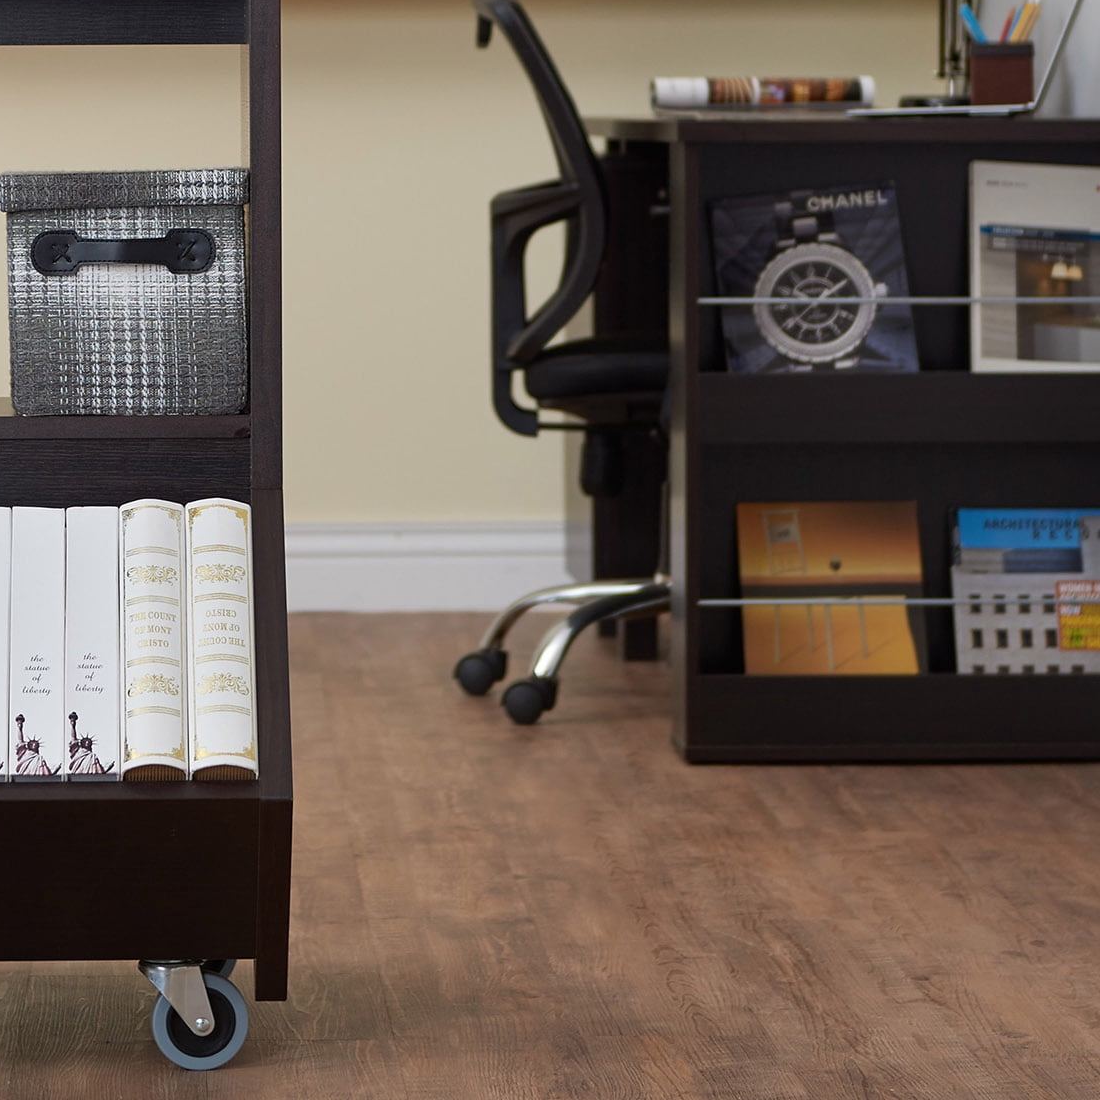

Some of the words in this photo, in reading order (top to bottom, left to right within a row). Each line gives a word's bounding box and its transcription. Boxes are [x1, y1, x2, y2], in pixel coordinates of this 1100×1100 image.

[807, 189, 888, 212] CHANEL
[129, 613, 146, 622] THE
[148, 611, 176, 622] COUNT
[205, 609, 237, 617] CRISTO
[134, 625, 145, 634] OF
[147, 625, 172, 634] MONT
[203, 623, 227, 632] MONT
[229, 623, 240, 632] OF
[137, 639, 170, 648] CRISTO
[198, 637, 227, 647] COUNT
[227, 637, 246, 647] THE
[30, 654, 44, 662] the
[83, 652, 96, 660] the
[32, 674, 42, 683] of
[85, 672, 95, 681] of
[22, 686, 52, 696] liberty
[75, 684, 104, 694] liberty
